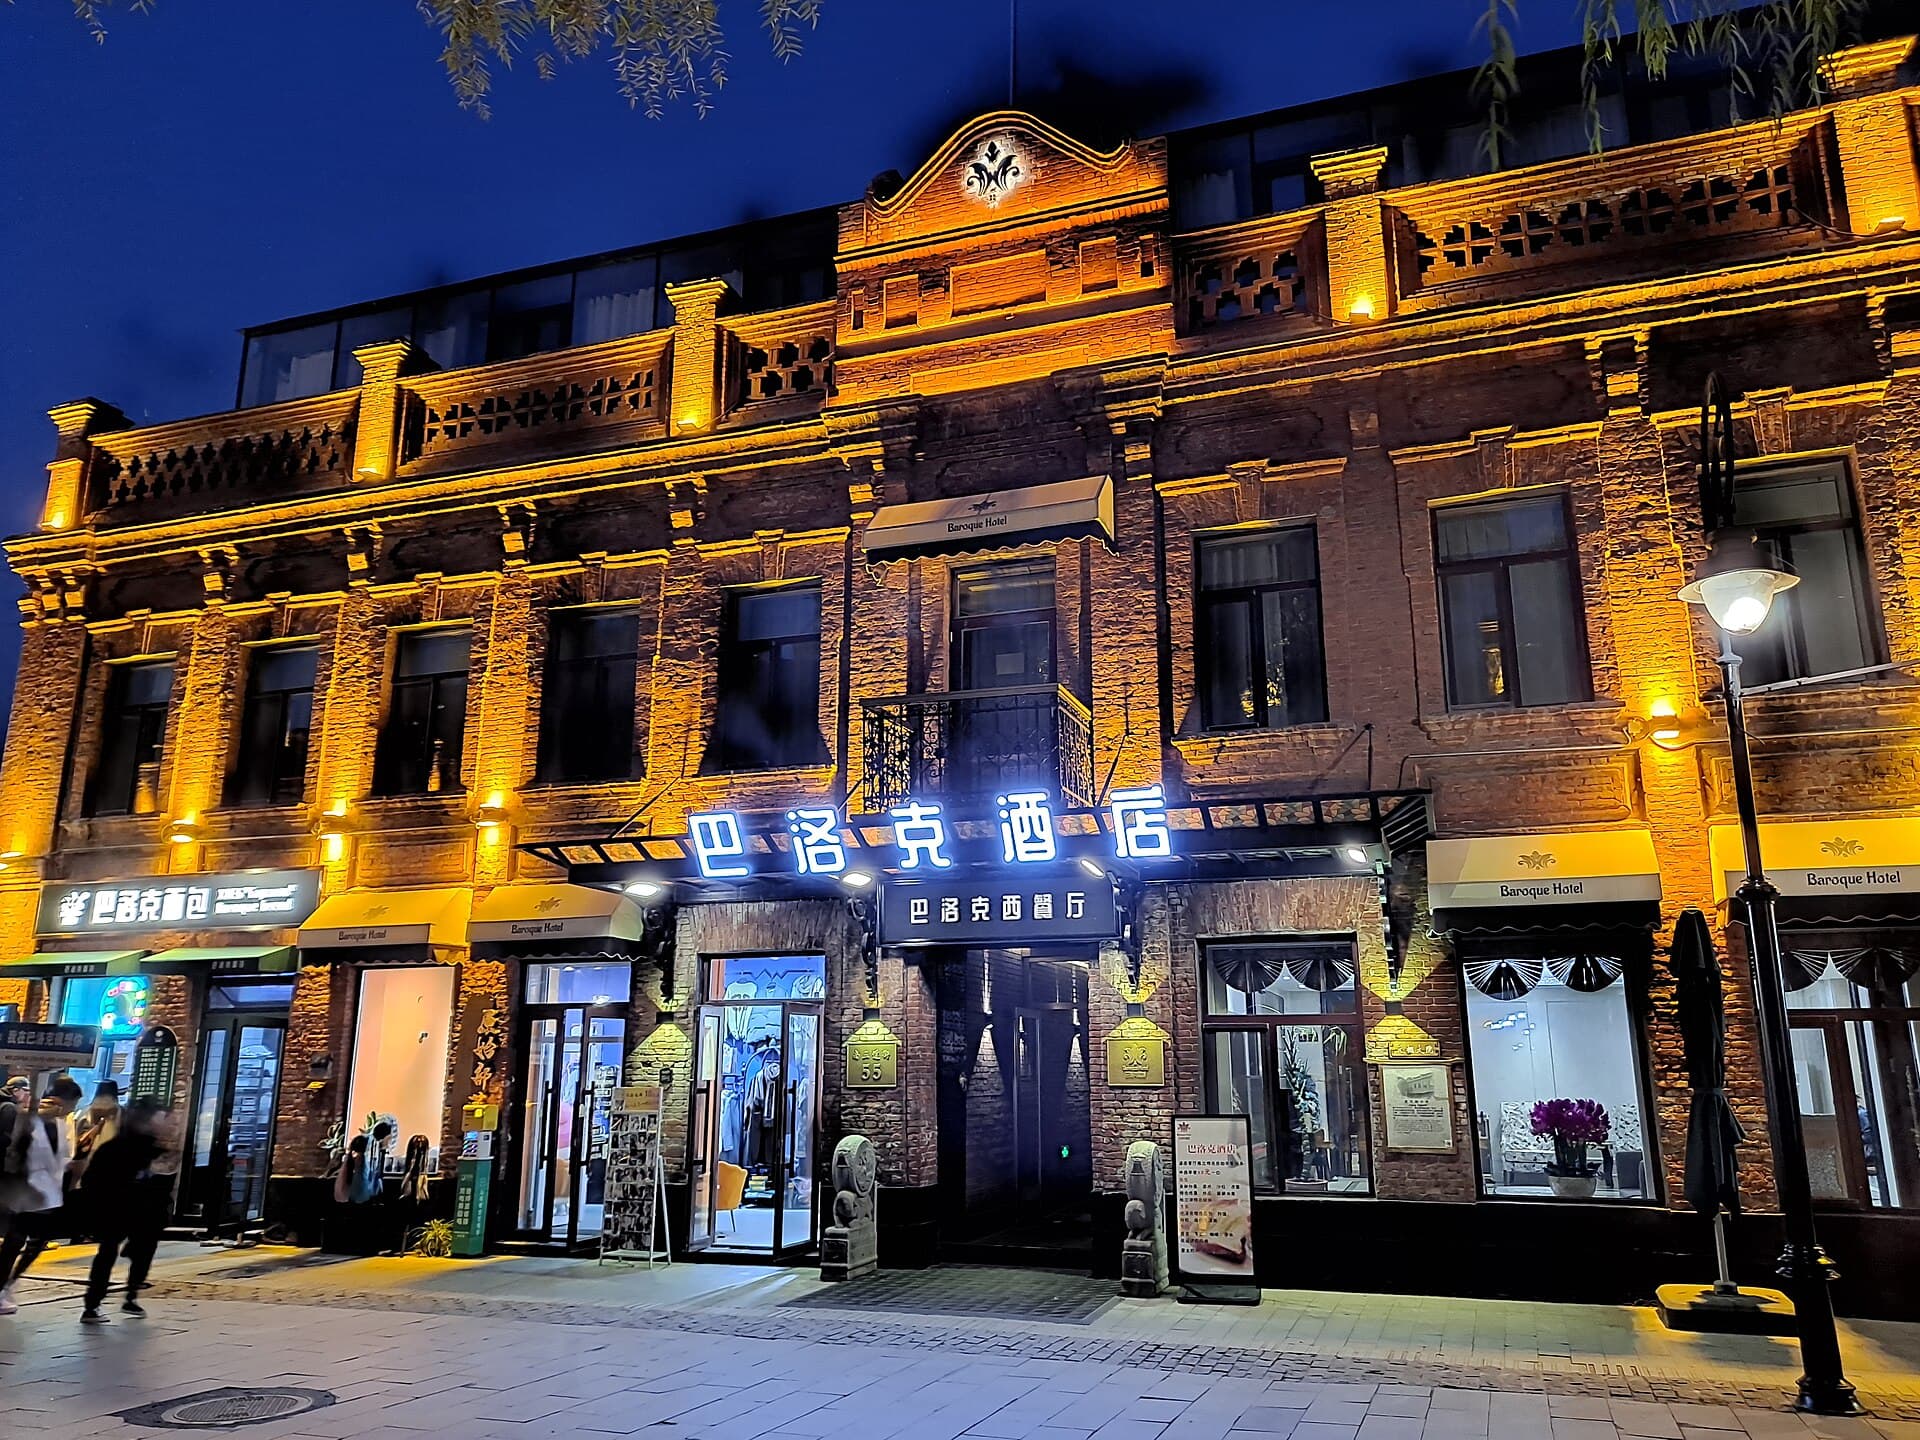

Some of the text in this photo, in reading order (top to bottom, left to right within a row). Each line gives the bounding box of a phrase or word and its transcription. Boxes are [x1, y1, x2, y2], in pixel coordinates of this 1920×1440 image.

[947, 515, 1007, 532] Baroque Hotel
[688, 785, 1174, 879] 巴洛克酒店
[1806, 871, 1901, 889] Baroque Hotel
[1500, 882, 1584, 899] Baroque Hotel
[92, 886, 211, 925] 巴洛克面包
[910, 891, 1086, 925] 巴洛克西餐厅
[511, 922, 564, 936] Baroque Hotel
[861, 1062, 882, 1080] 55
